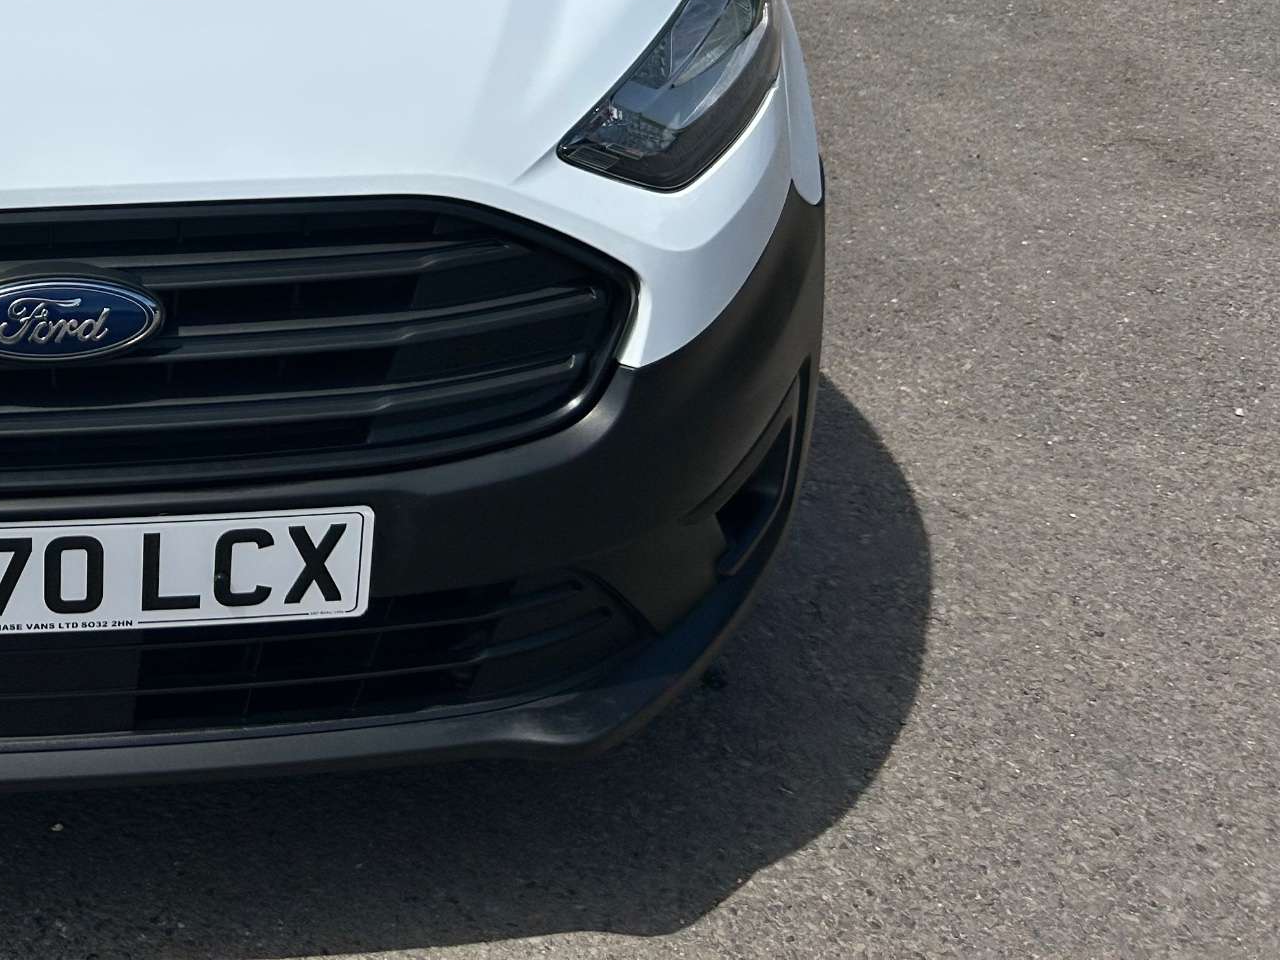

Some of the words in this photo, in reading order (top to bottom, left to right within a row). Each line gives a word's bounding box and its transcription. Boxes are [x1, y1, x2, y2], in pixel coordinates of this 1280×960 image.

[141, 523, 348, 612] LCX
[25, 622, 56, 630] VANS
[58, 621, 79, 629] LTD
[111, 619, 133, 628] 2HN
